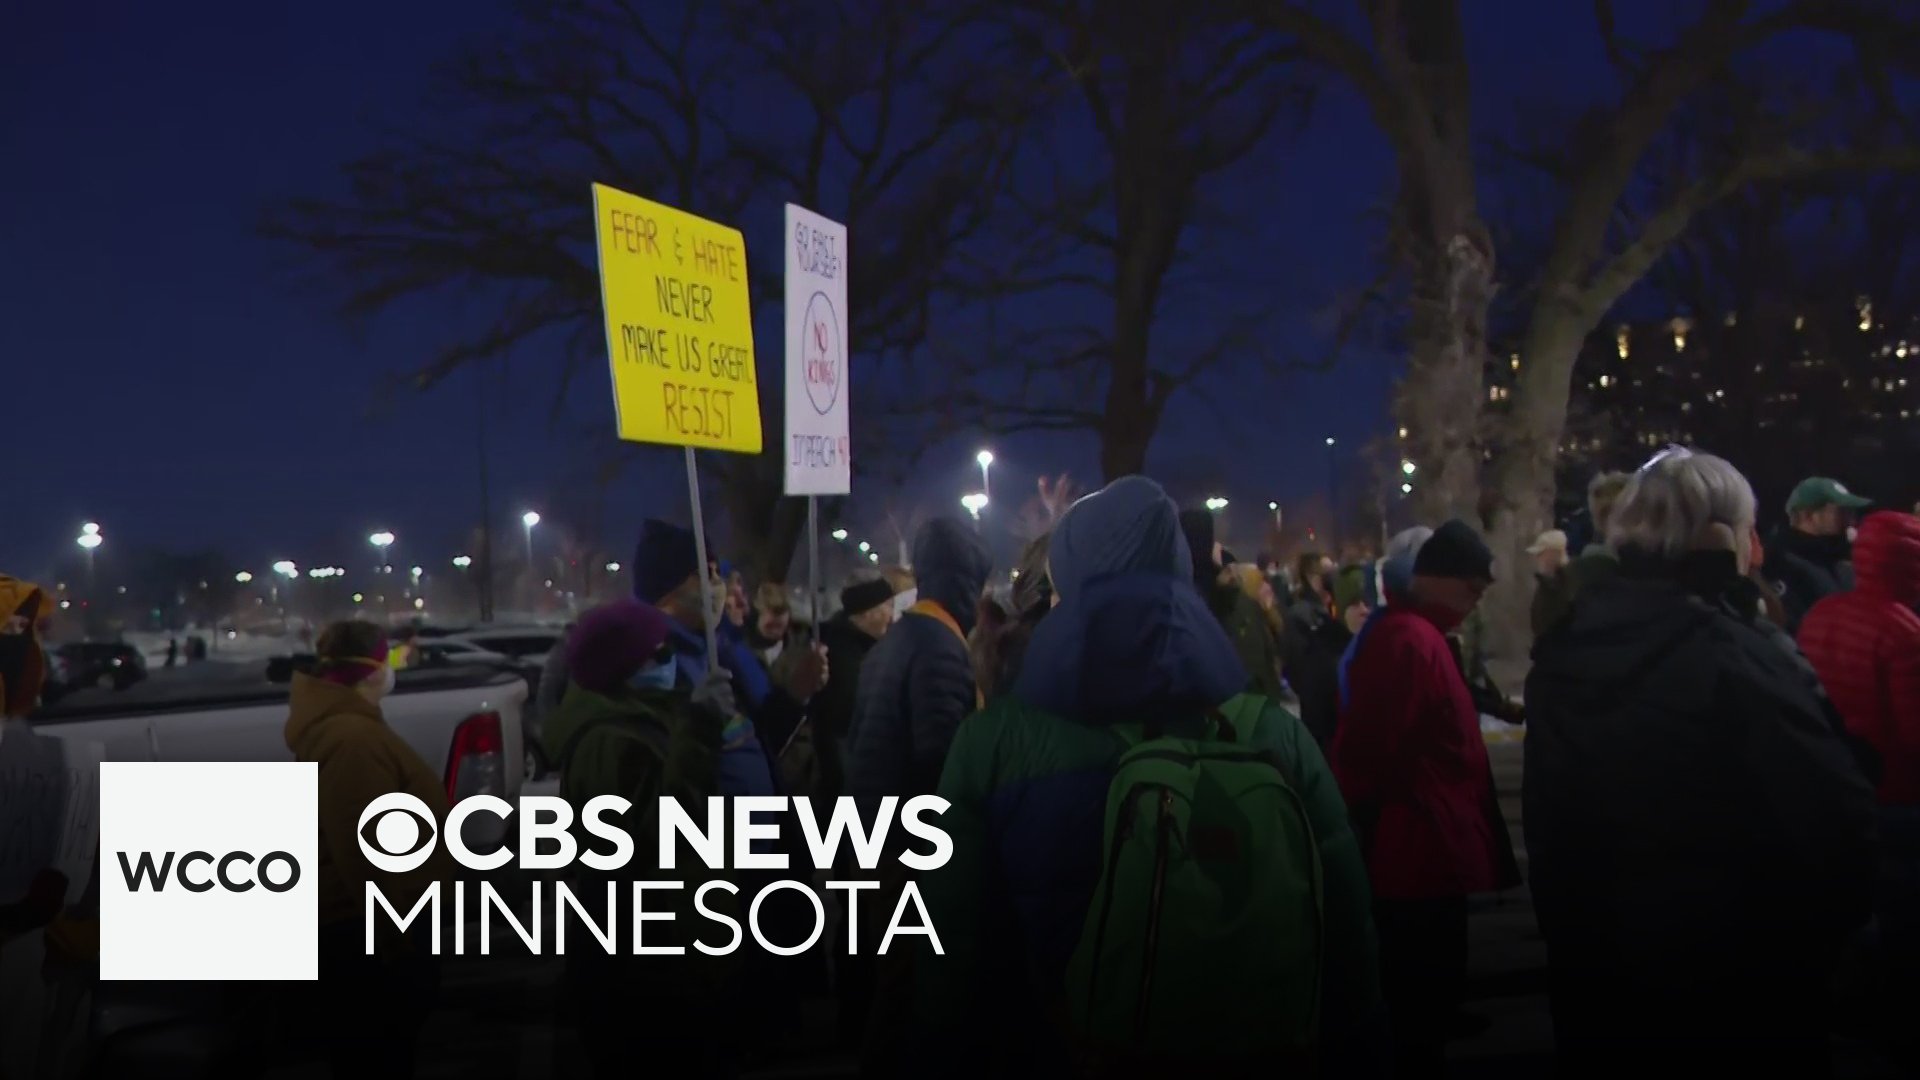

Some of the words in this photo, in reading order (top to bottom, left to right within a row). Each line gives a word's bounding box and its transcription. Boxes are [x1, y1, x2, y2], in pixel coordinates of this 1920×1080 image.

[611, 209, 661, 258] FEAR
[673, 226, 684, 266] &
[692, 236, 738, 282] HATE
[655, 275, 714, 324] NEVER
[621, 323, 671, 369] MAKE
[677, 335, 700, 372] US
[708, 341, 753, 384] GREAT
[814, 321, 828, 353] NO
[663, 382, 735, 440] RESIST
